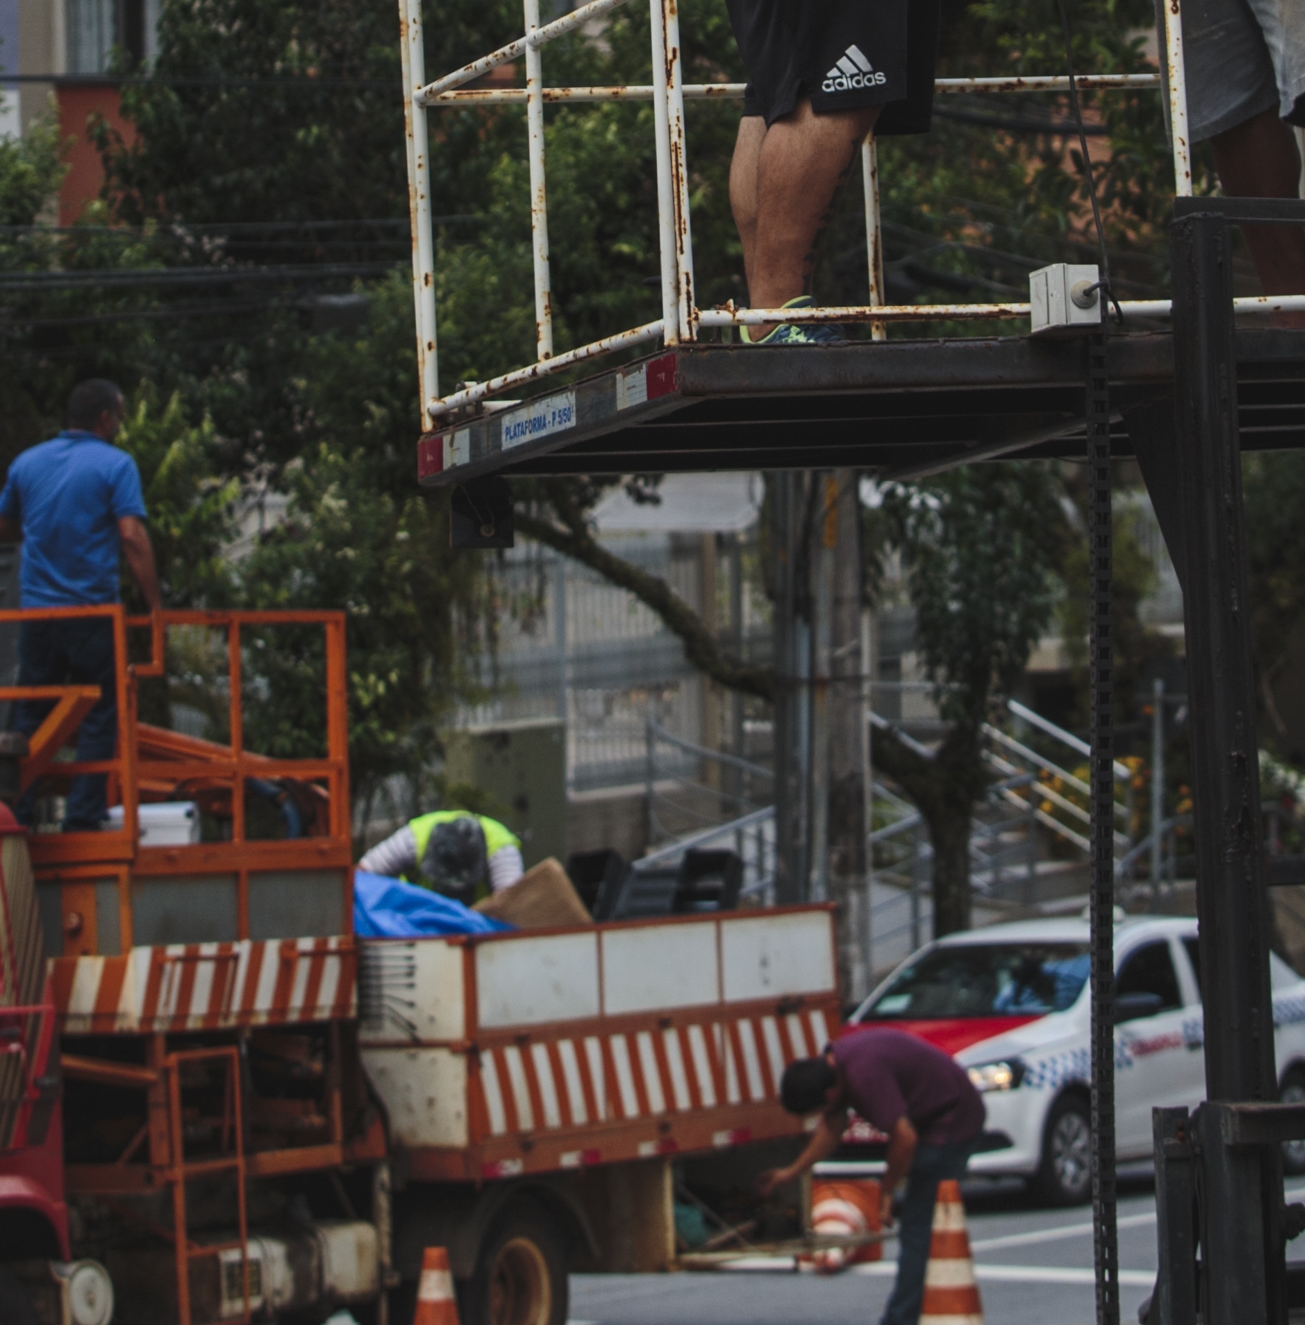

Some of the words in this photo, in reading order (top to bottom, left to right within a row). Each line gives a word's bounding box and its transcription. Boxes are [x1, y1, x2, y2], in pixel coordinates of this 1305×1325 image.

[821, 72, 887, 93] adidas
[505, 414, 547, 442] PLATAFORMA
[552, 411, 557, 427] P
